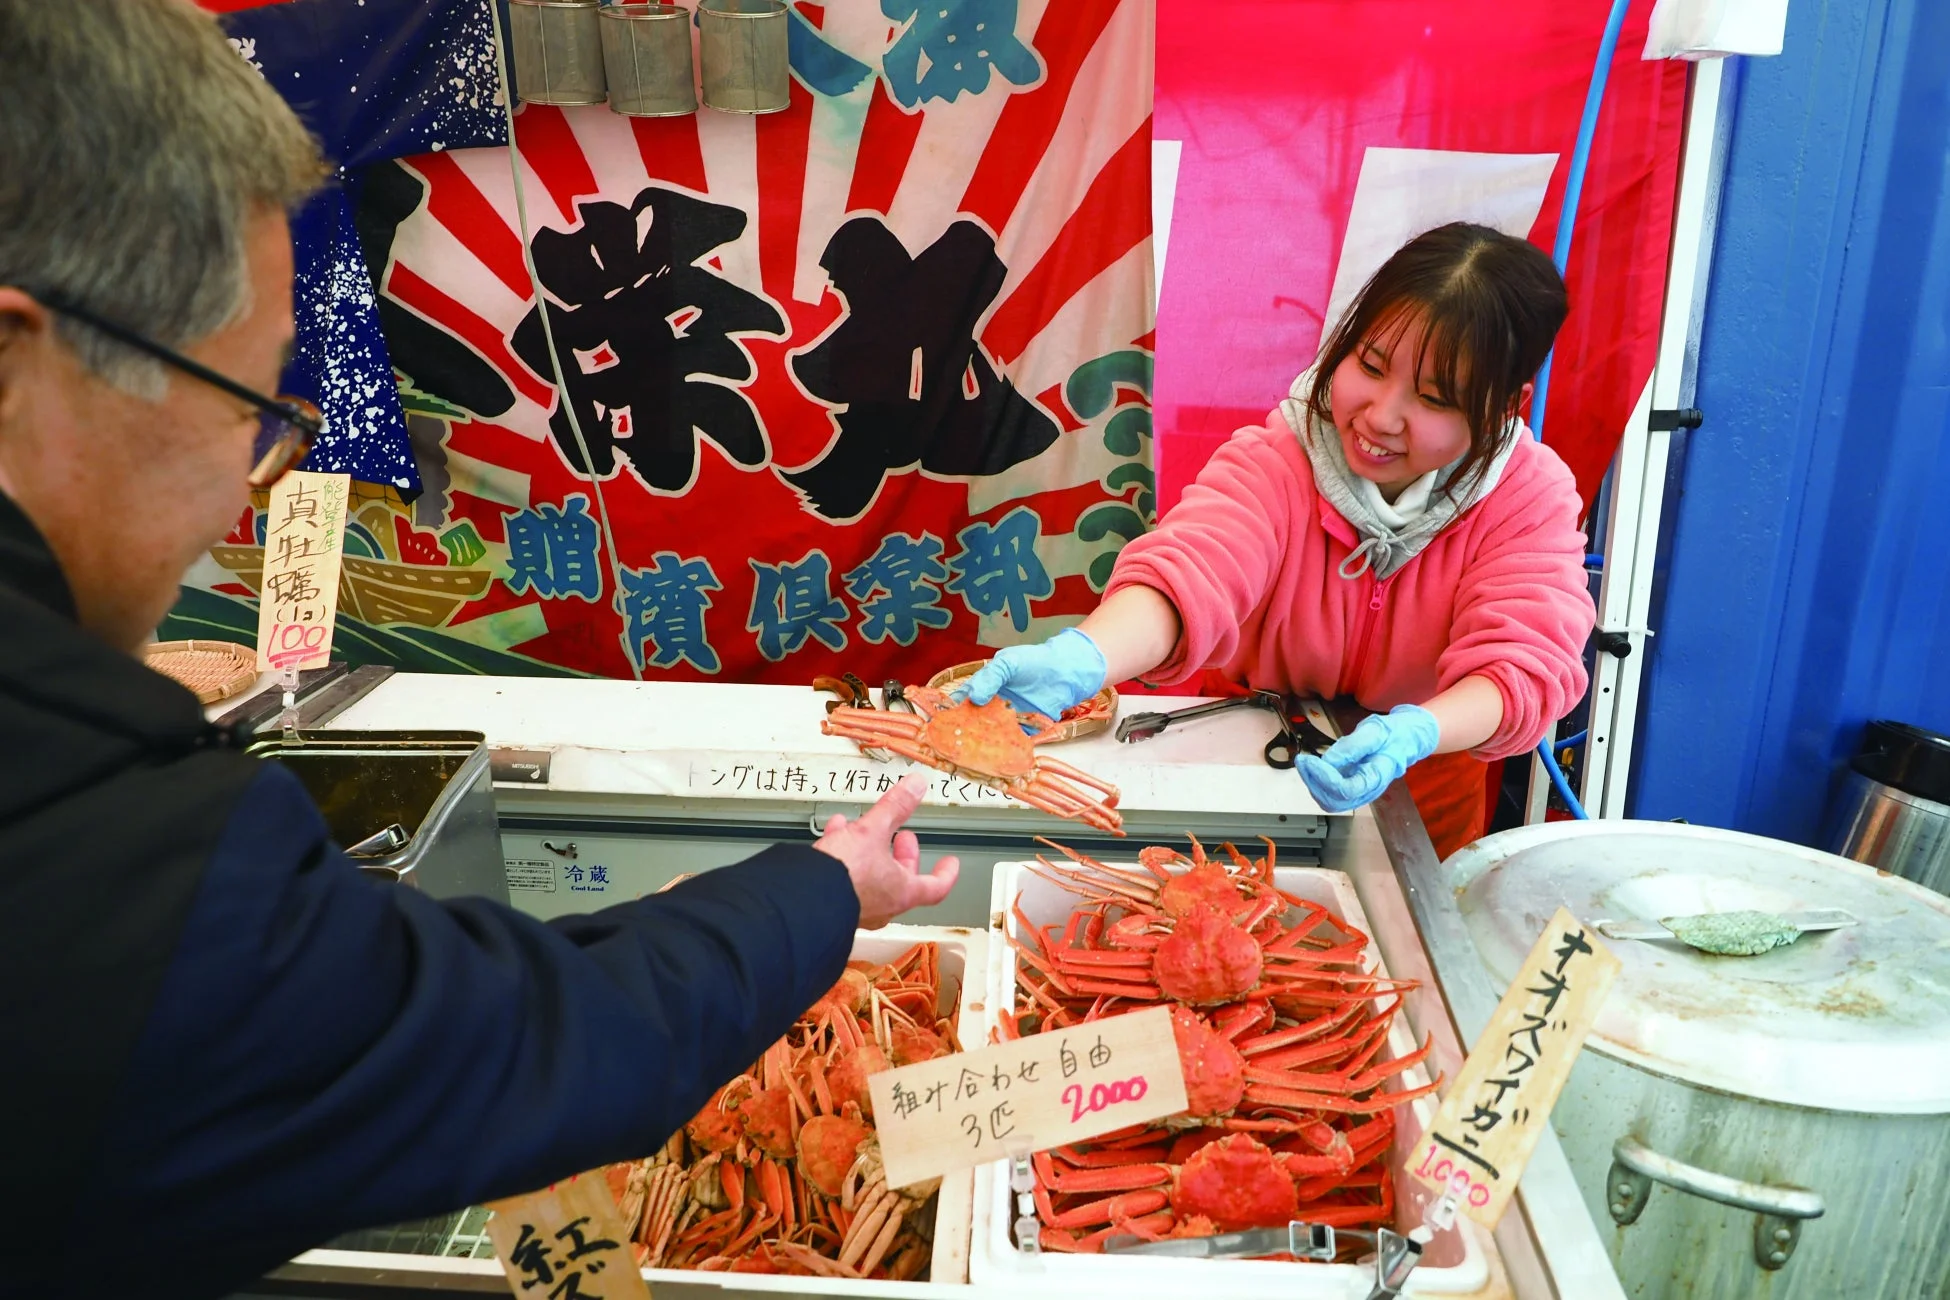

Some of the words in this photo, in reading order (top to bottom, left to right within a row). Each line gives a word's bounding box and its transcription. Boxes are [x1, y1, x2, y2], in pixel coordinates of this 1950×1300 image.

[267, 481, 322, 604] 真牡蠣
[267, 624, 326, 658] 100
[564, 864, 610, 884] 冷蔵
[1432, 929, 1593, 1181] オオズワイガニ
[961, 1100, 1015, 1148] 3匹
[1061, 1075, 1149, 1124] 2000
